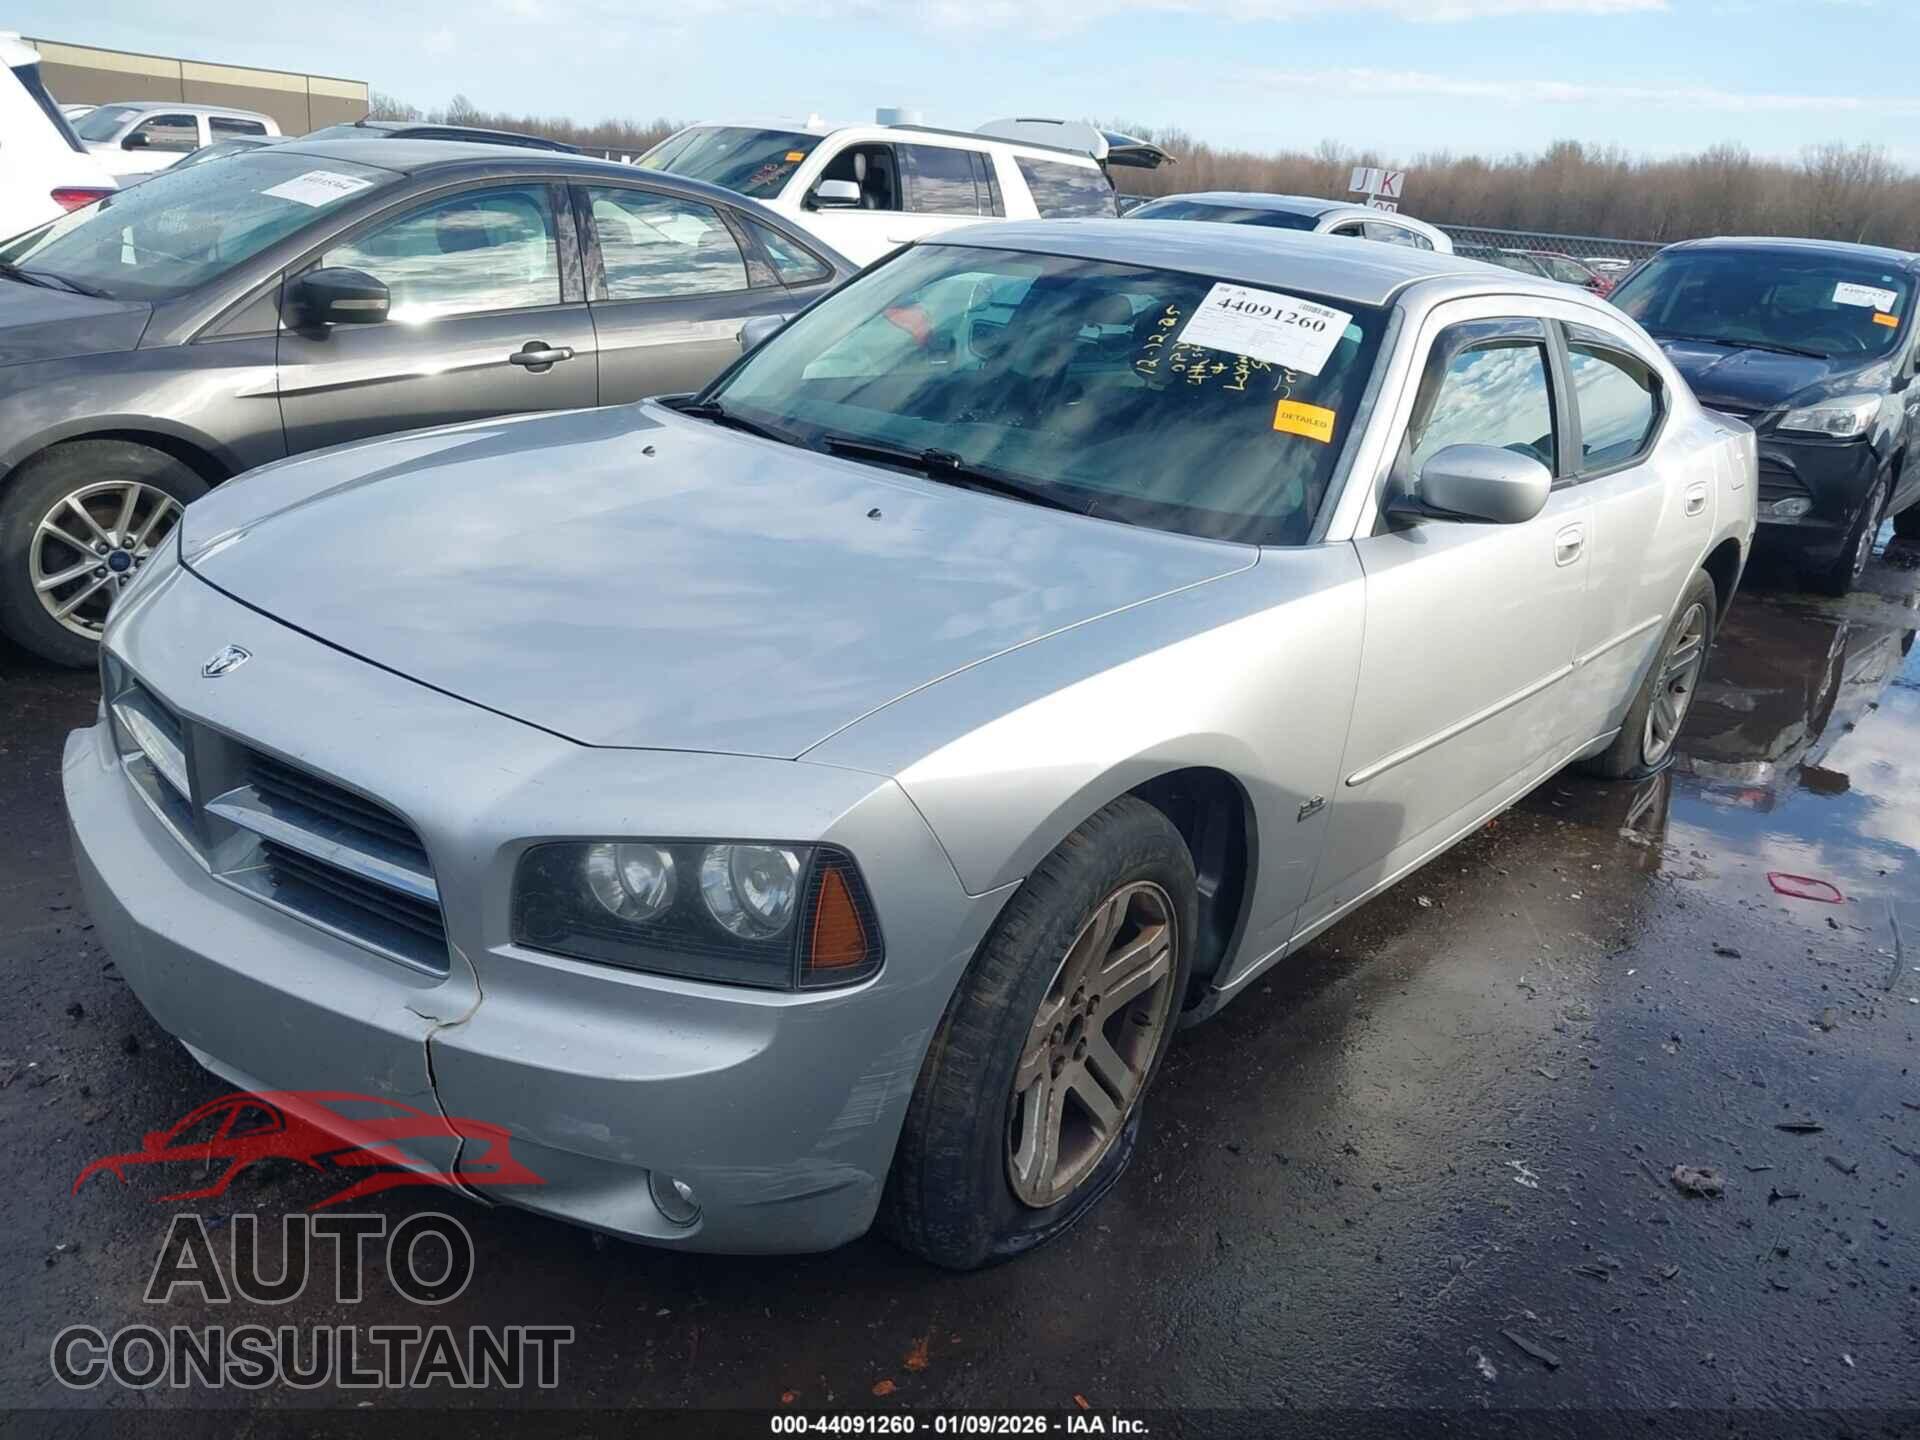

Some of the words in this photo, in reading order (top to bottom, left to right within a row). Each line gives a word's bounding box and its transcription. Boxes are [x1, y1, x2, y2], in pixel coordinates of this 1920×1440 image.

[1355, 168, 1369, 191] J
[1380, 171, 1399, 195] K
[1216, 297, 1327, 333] 44091260
[1280, 411, 1328, 429] DETAILED
